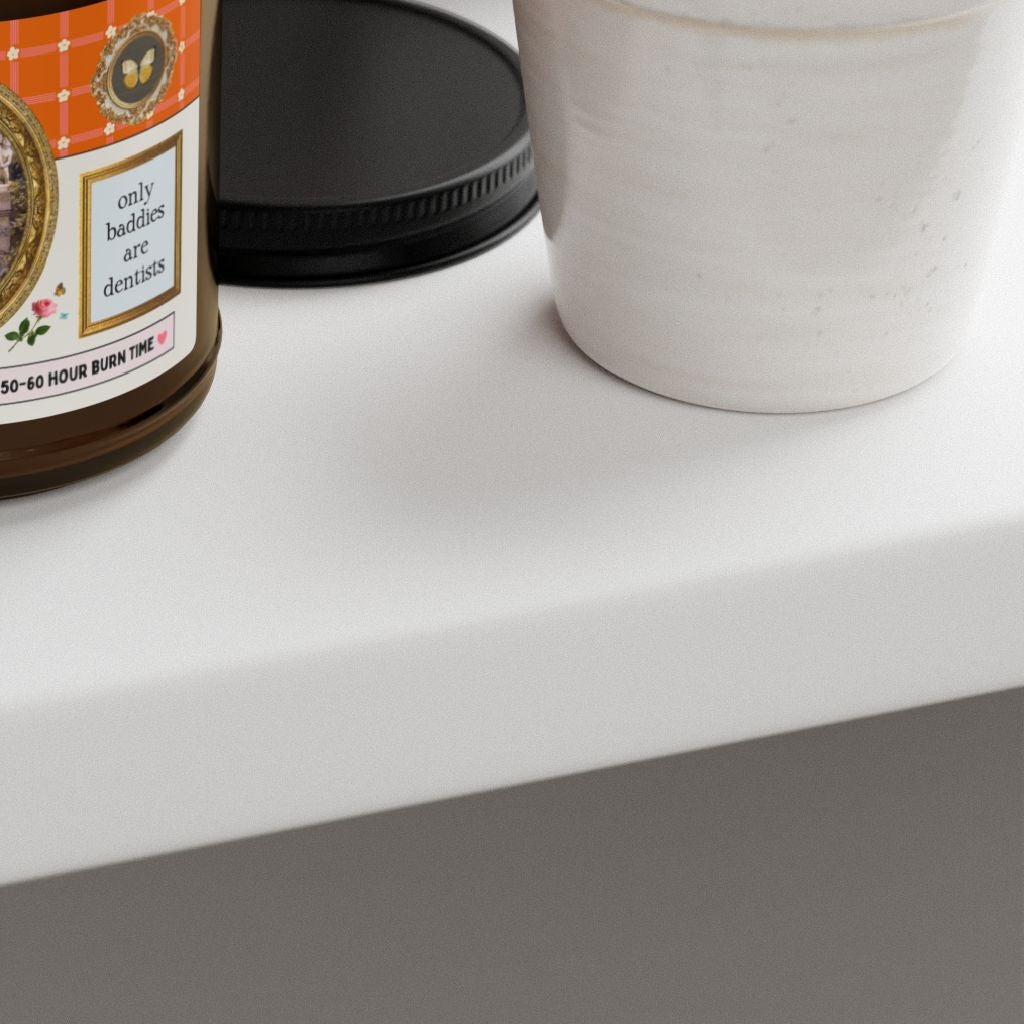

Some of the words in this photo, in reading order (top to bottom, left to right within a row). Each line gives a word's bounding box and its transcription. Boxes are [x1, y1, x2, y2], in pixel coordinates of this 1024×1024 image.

[117, 180, 155, 210] only
[106, 203, 166, 242] baddies
[123, 239, 150, 263] are
[103, 258, 166, 298] dentists
[0, 375, 45, 395] 50-60
[48, 363, 88, 387] HOUR
[91, 349, 127, 376] BURN
[129, 336, 155, 361] TIME
